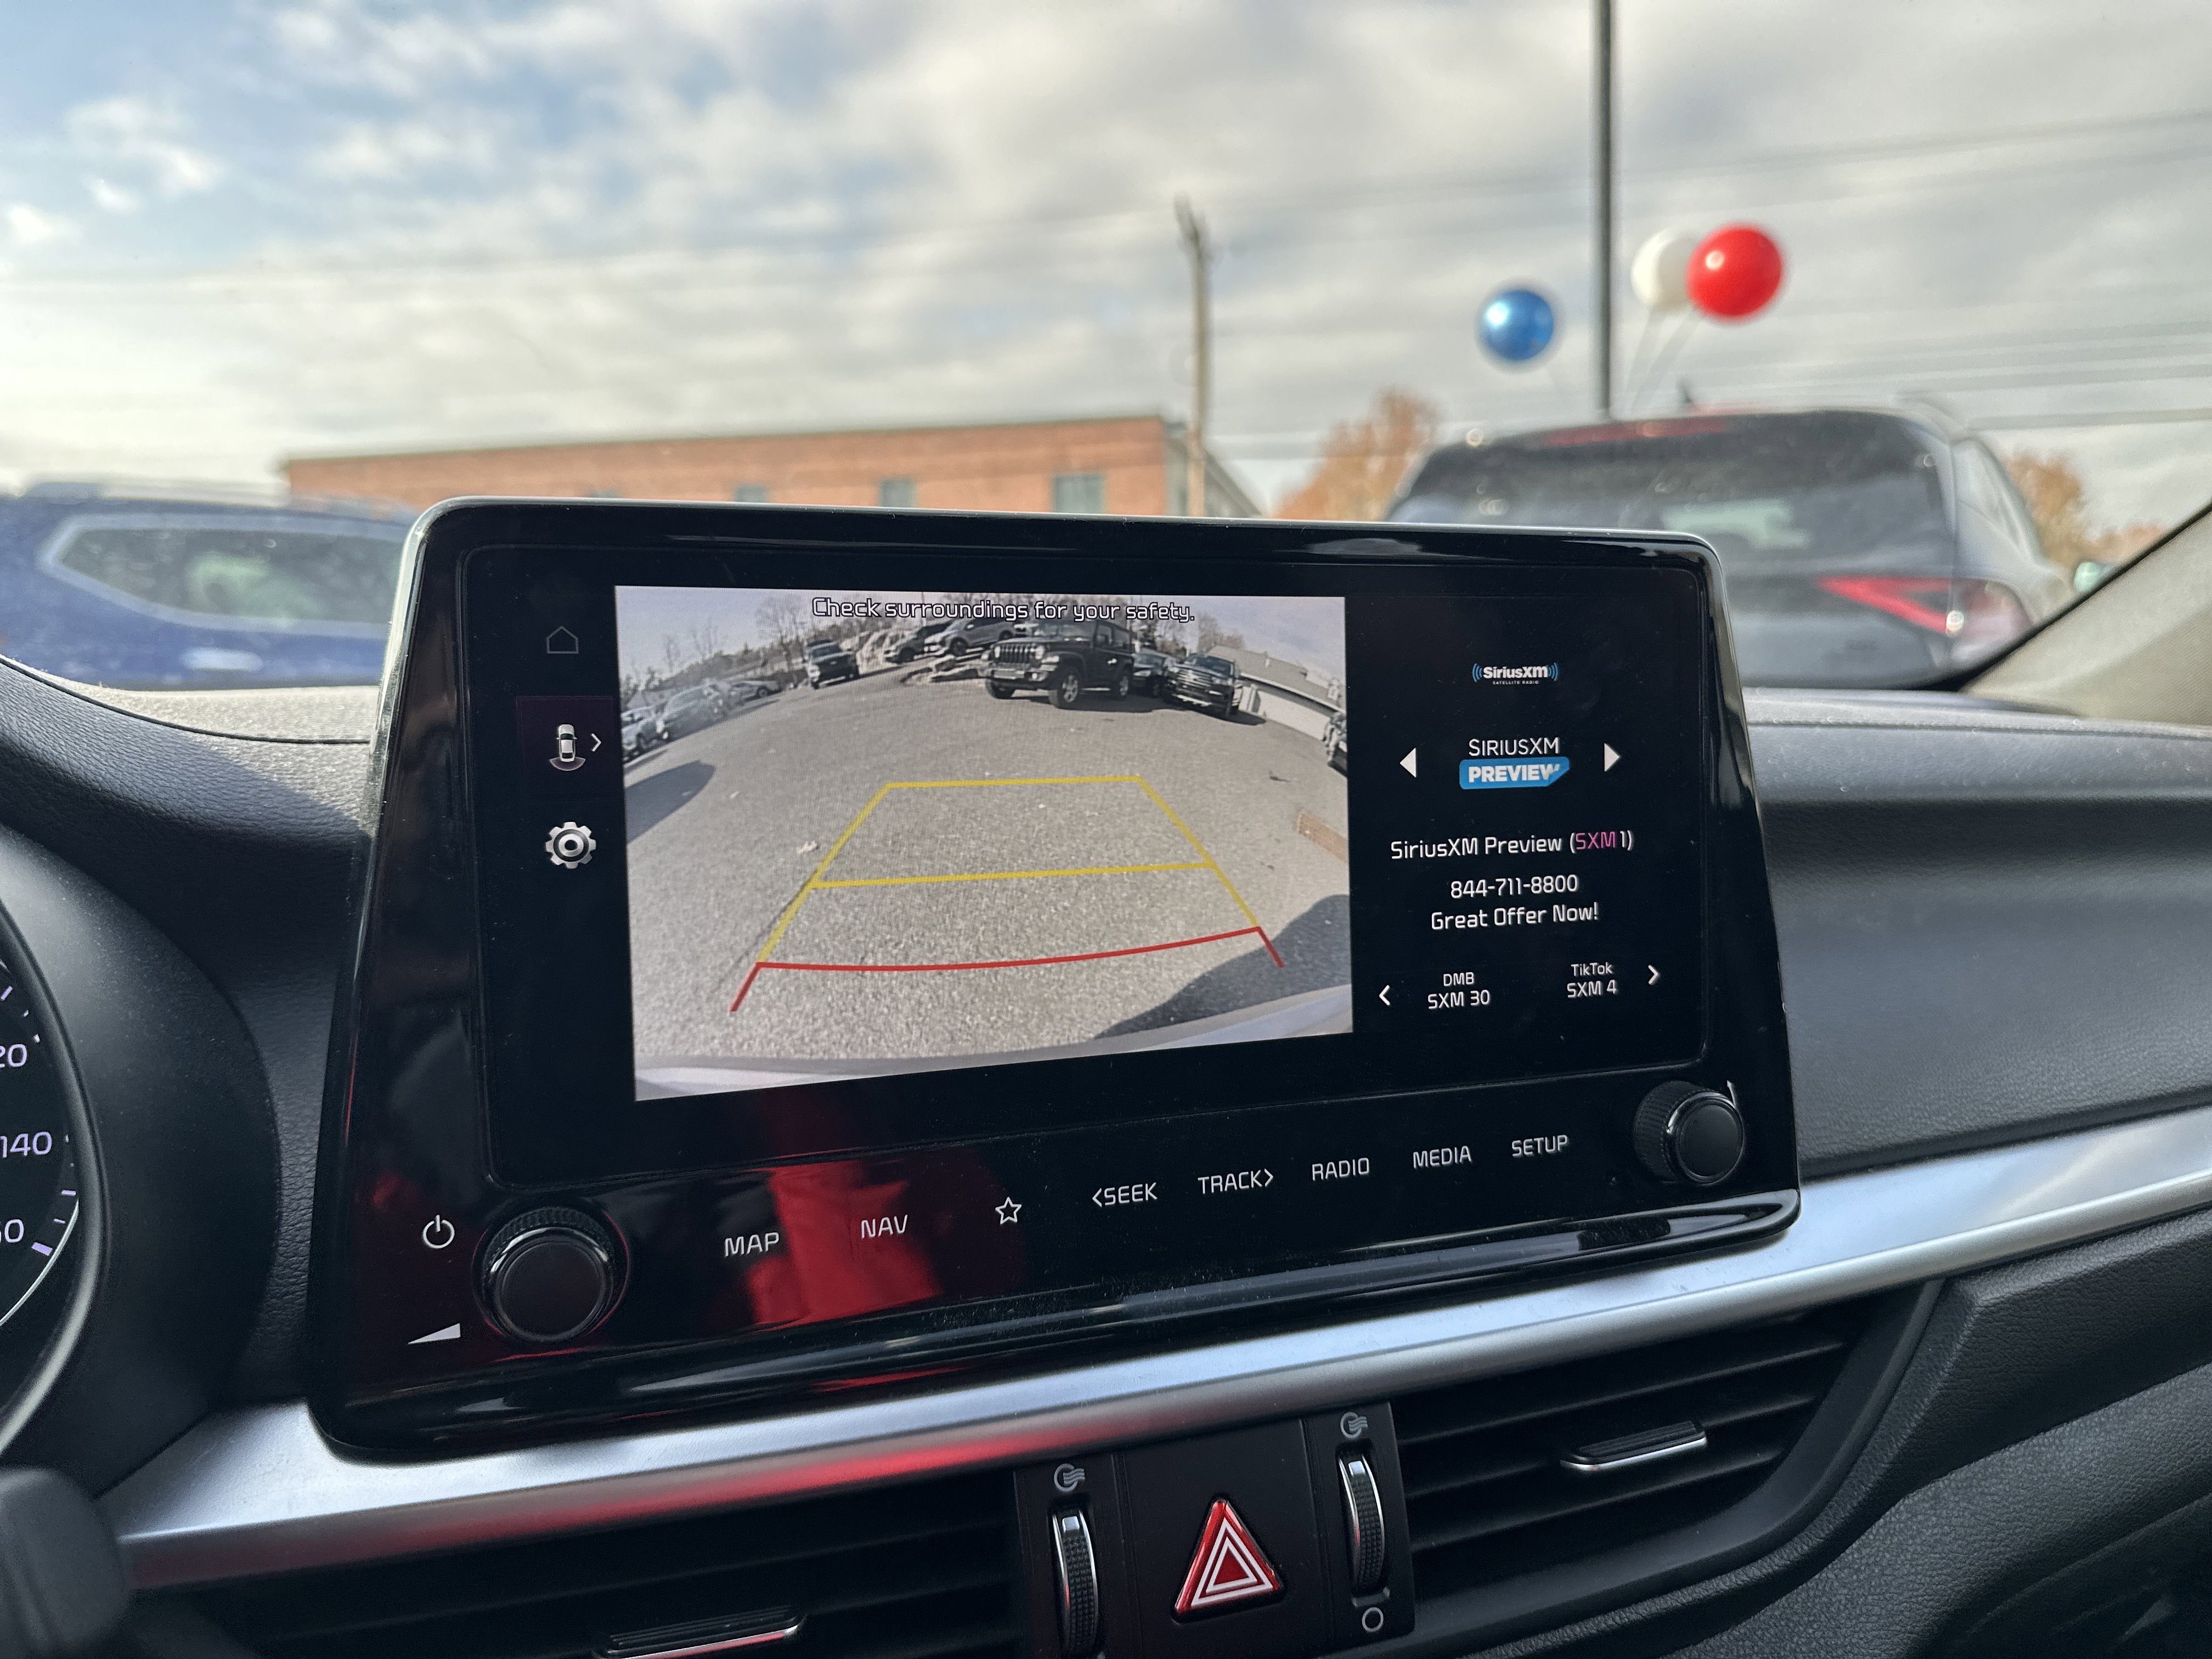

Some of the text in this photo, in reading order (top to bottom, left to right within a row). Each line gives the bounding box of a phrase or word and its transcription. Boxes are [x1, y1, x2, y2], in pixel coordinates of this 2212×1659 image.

[812, 597, 1195, 623] Check surroundings for your safety.
[1469, 737, 1559, 757] SIRIUSXM
[1468, 763, 1560, 783] PREVIEW
[1391, 837, 1479, 859] SiriusXM
[1485, 834, 1562, 855] Preview
[1570, 831, 1616, 854] (SXM
[1451, 874, 1578, 899] 844-711-8800
[1431, 901, 1598, 930] Great Offer Now!
[1443, 972, 1475, 986] DMB
[1571, 962, 1613, 977] TikTok
[1427, 989, 1491, 1009] SXM 30
[1567, 979, 1617, 998] SXM 4
[0, 1131, 52, 1158] 140
[1511, 1135, 1568, 1156] SETUP
[1413, 1146, 1472, 1169] MEDIA
[1312, 1158, 1370, 1181] RADIO
[861, 1214, 909, 1239] NAV
[725, 1232, 780, 1257] MAP
